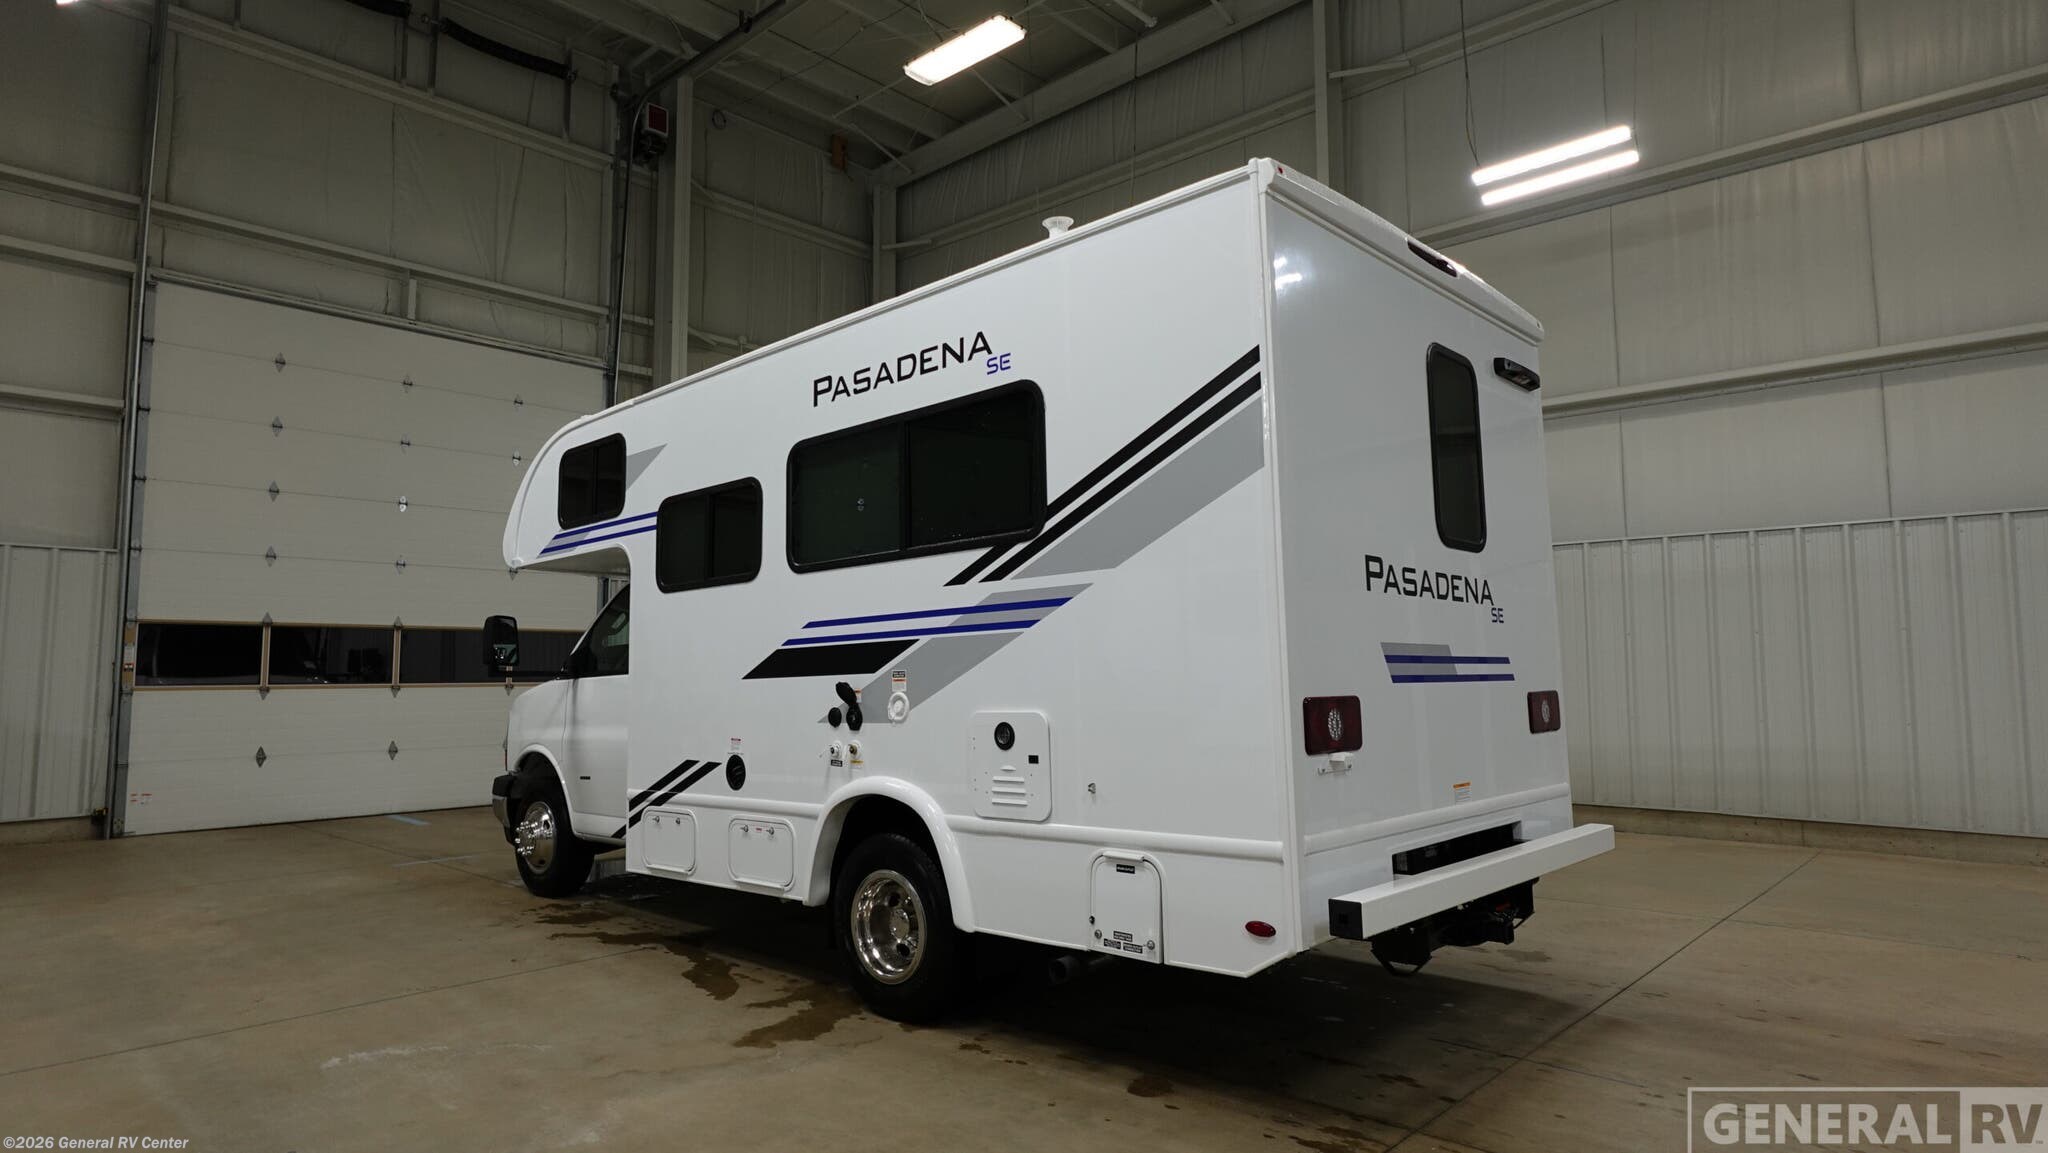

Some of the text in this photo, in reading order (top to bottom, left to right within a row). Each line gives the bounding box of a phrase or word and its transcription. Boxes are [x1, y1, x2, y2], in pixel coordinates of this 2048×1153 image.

[813, 331, 993, 408] PASADENA
[986, 353, 1011, 375] SE
[1364, 554, 1495, 606] PASADENA
[1491, 607, 1505, 623] SE
